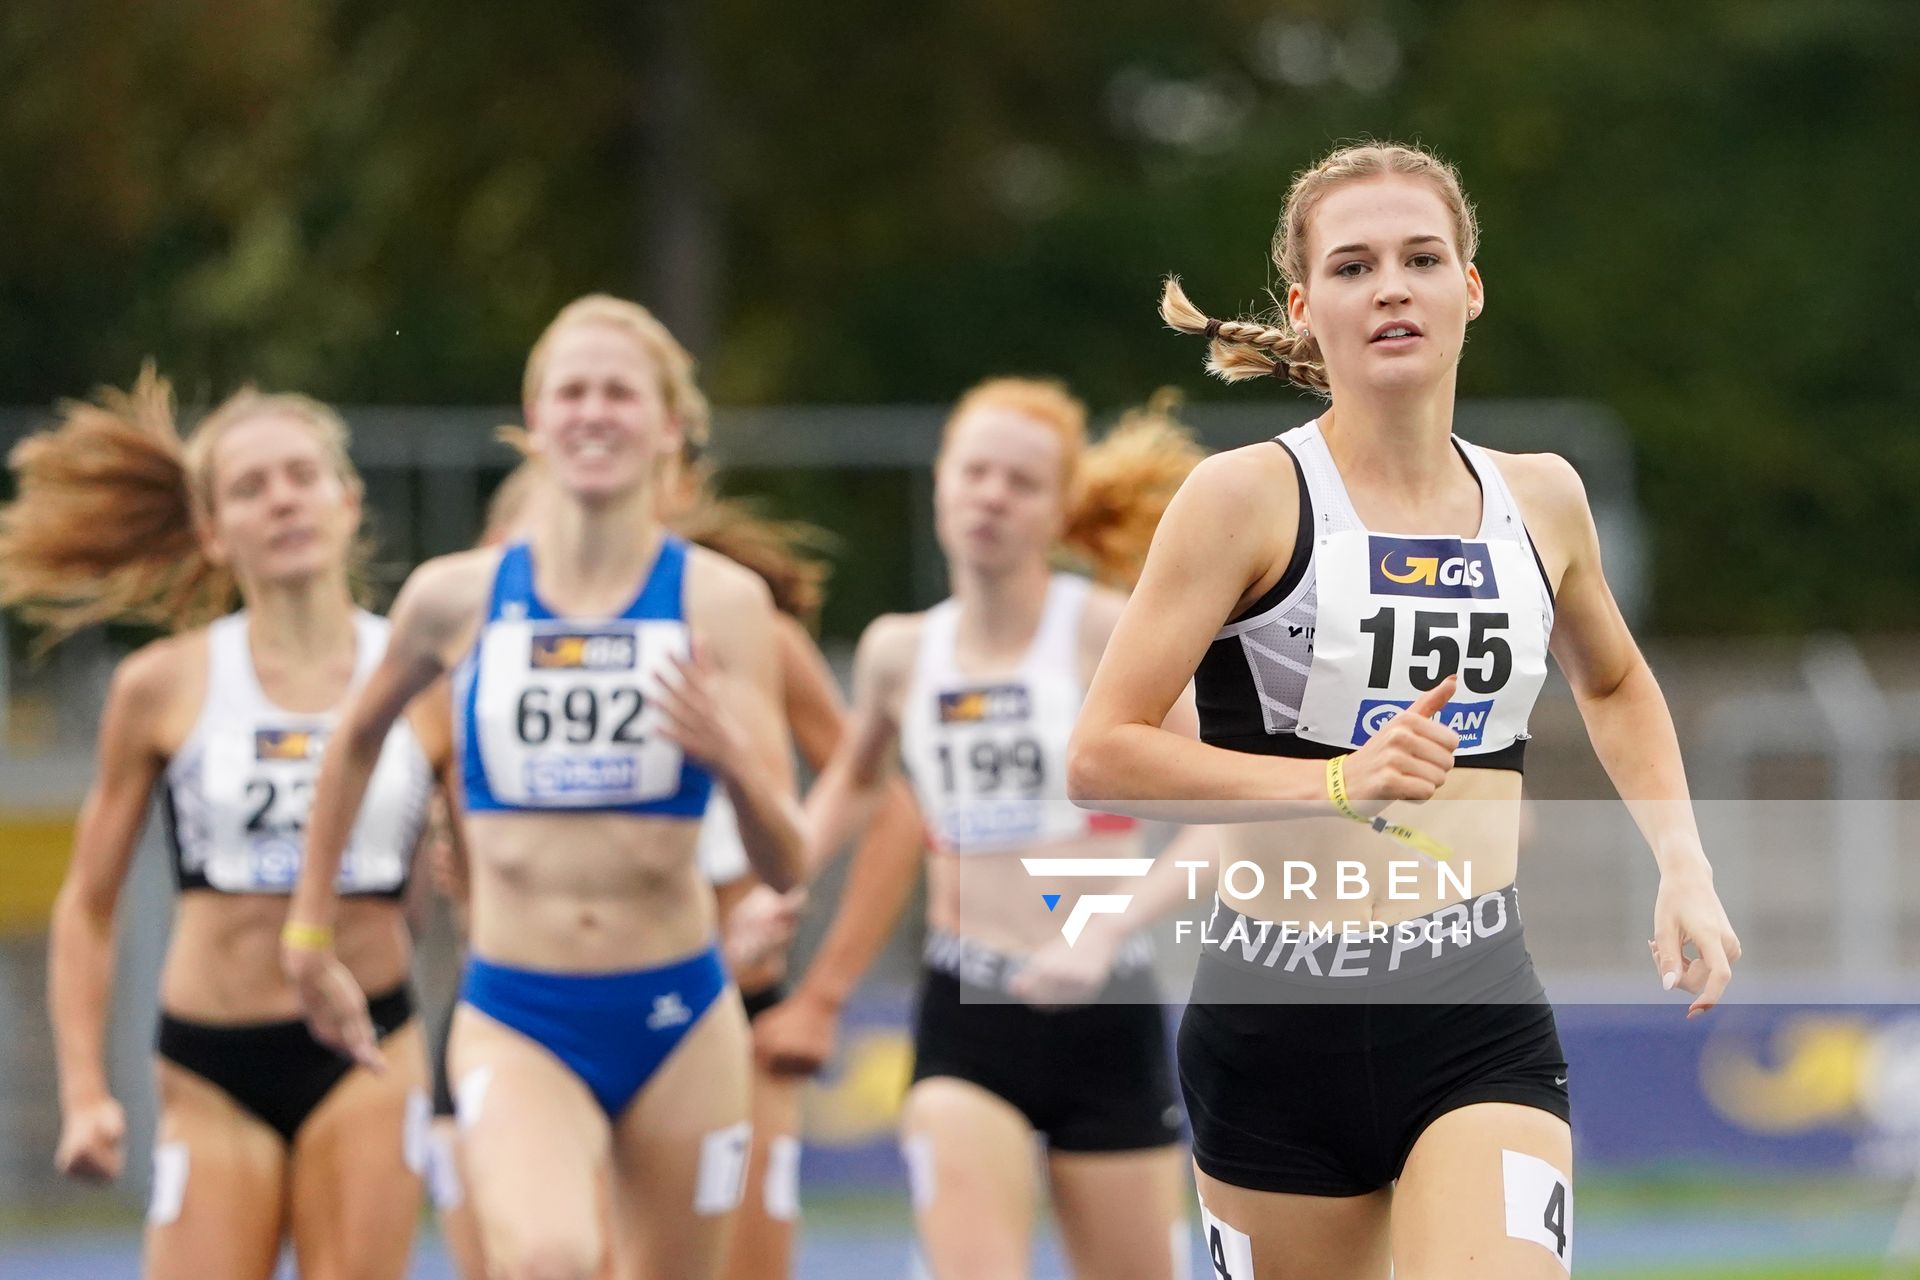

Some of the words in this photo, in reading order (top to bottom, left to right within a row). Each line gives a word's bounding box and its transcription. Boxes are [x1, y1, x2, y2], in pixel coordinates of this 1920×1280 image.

[1439, 557, 1484, 588] GLS
[1360, 607, 1512, 694] 155
[515, 686, 645, 745] 692
[937, 739, 1046, 792] 199
[1219, 914, 1370, 977] NIKE
[1388, 891, 1507, 971] PRO
[1544, 1180, 1566, 1258] 4
